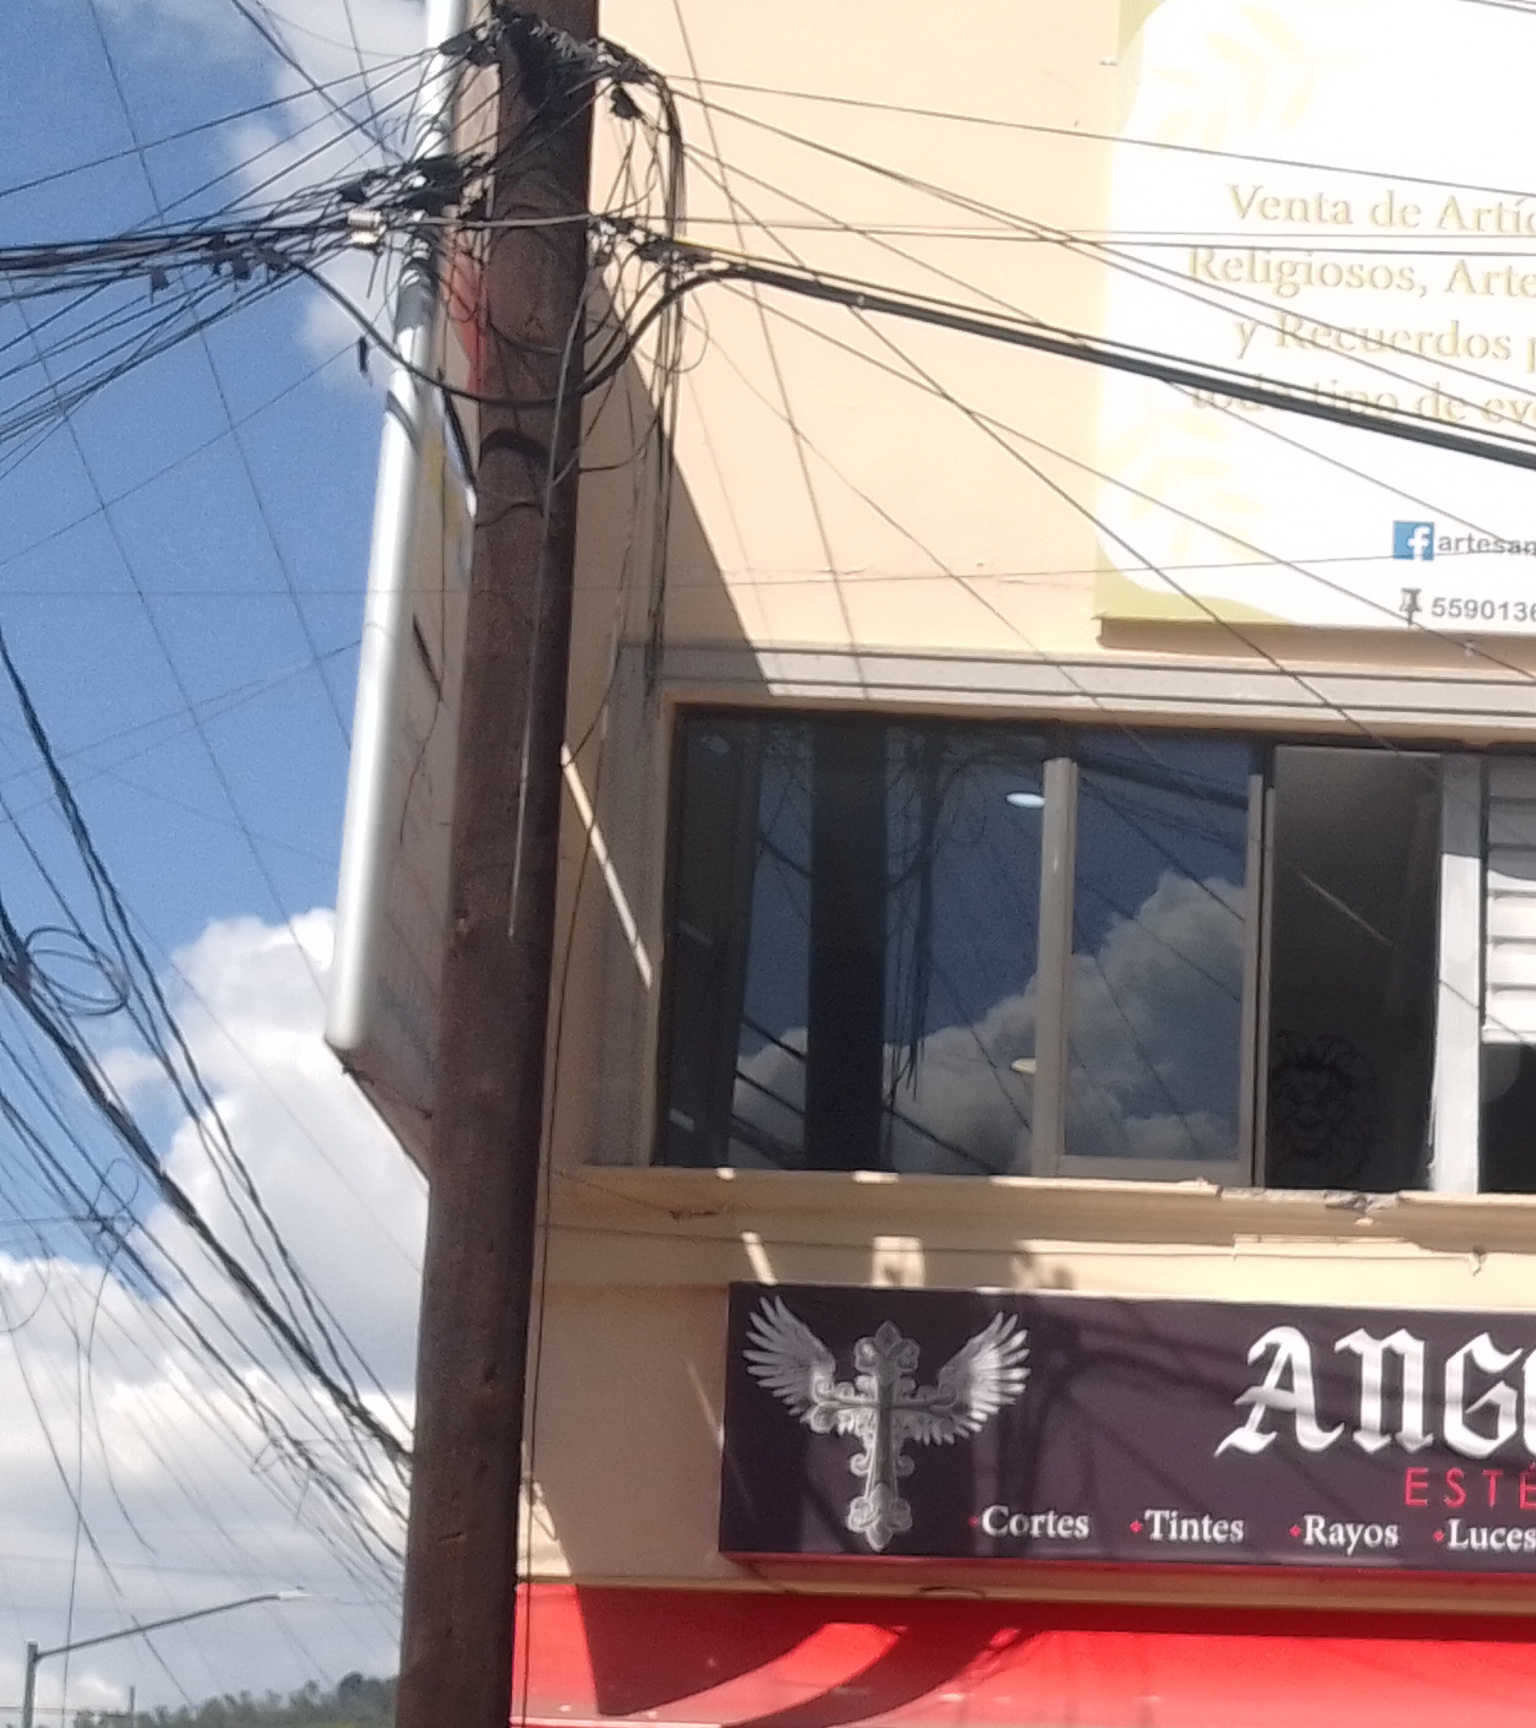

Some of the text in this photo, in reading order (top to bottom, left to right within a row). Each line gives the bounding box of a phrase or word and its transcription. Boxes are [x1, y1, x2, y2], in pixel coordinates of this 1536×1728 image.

[1227, 183, 1354, 226] Venta
[1368, 189, 1421, 230] de
[1187, 243, 1428, 298] Religiosos,
[1233, 318, 1262, 360] y
[1274, 311, 1512, 361] Recuerdos
[1416, 381, 1466, 421] de
[981, 1505, 1093, 1540] Cortes
[1144, 1509, 1246, 1544] Tintes
[1302, 1515, 1402, 1556] Rayos
